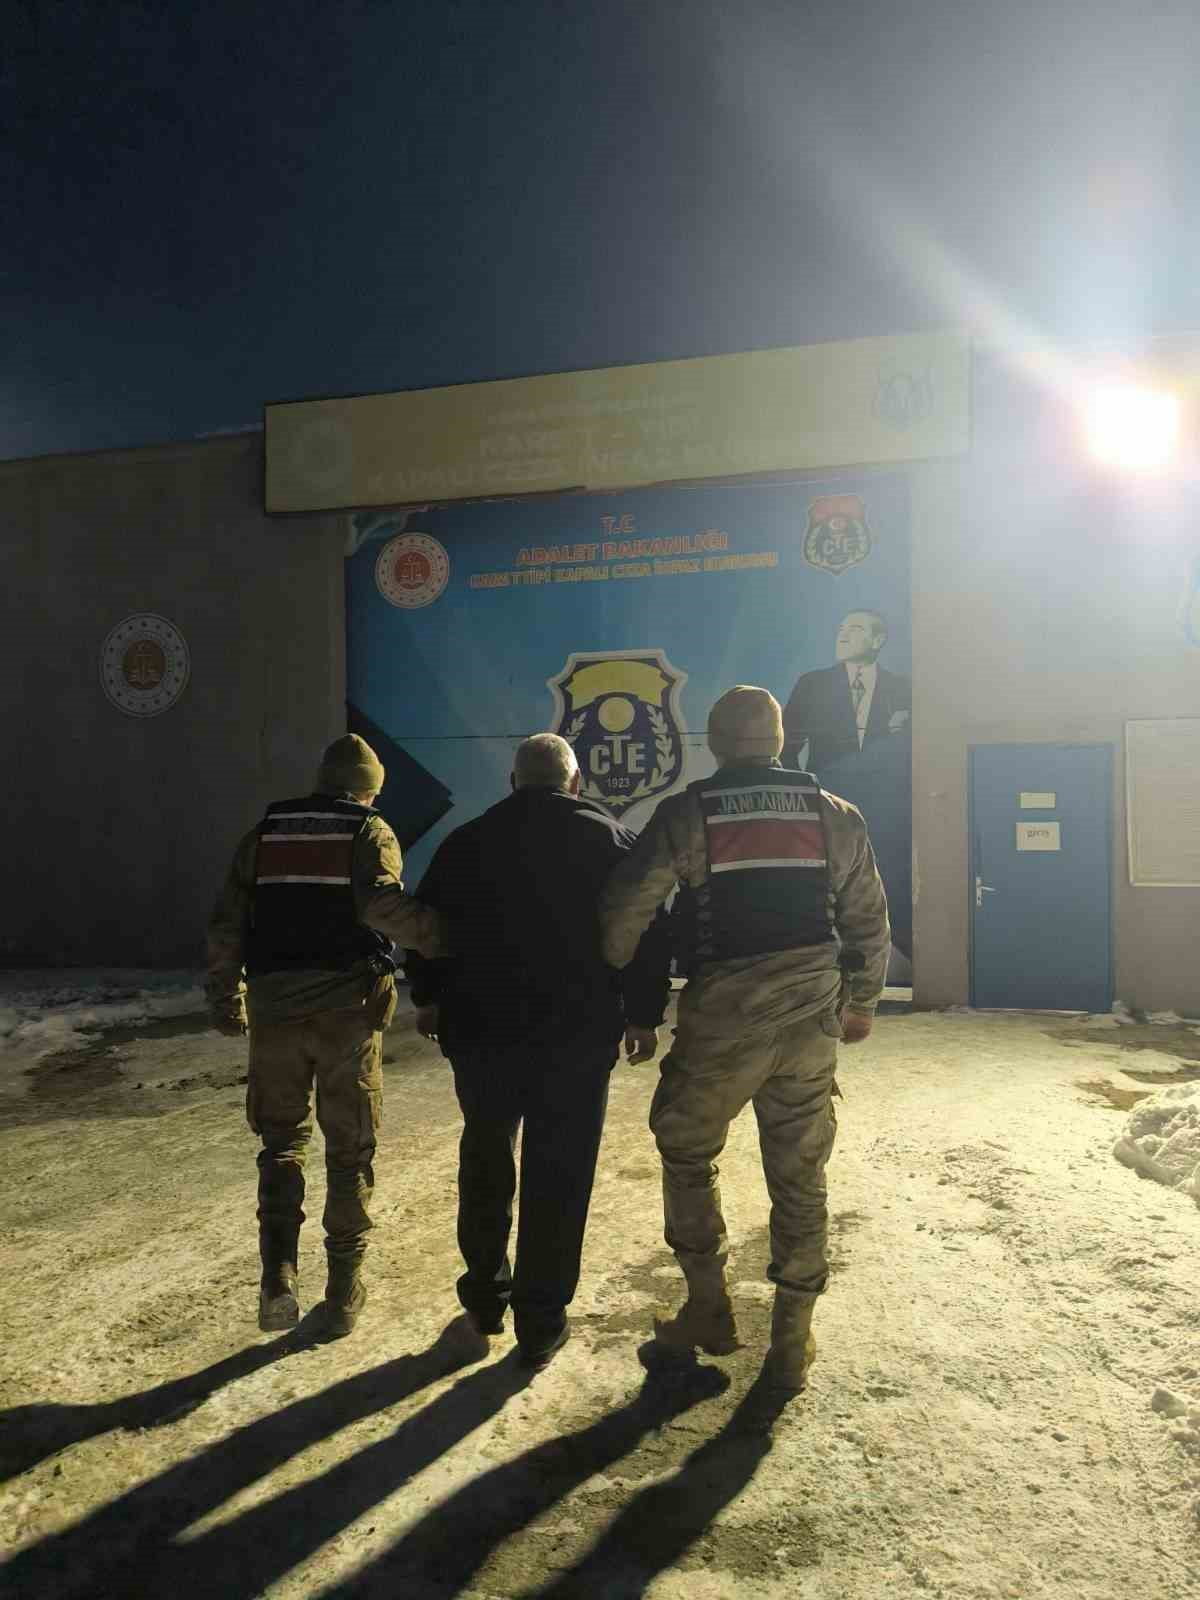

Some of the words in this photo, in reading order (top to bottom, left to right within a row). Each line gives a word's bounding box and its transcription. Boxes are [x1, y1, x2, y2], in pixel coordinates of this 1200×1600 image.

[516, 543, 598, 564] ADALET
[590, 735, 646, 775] CTE
[607, 777, 631, 788] 1923
